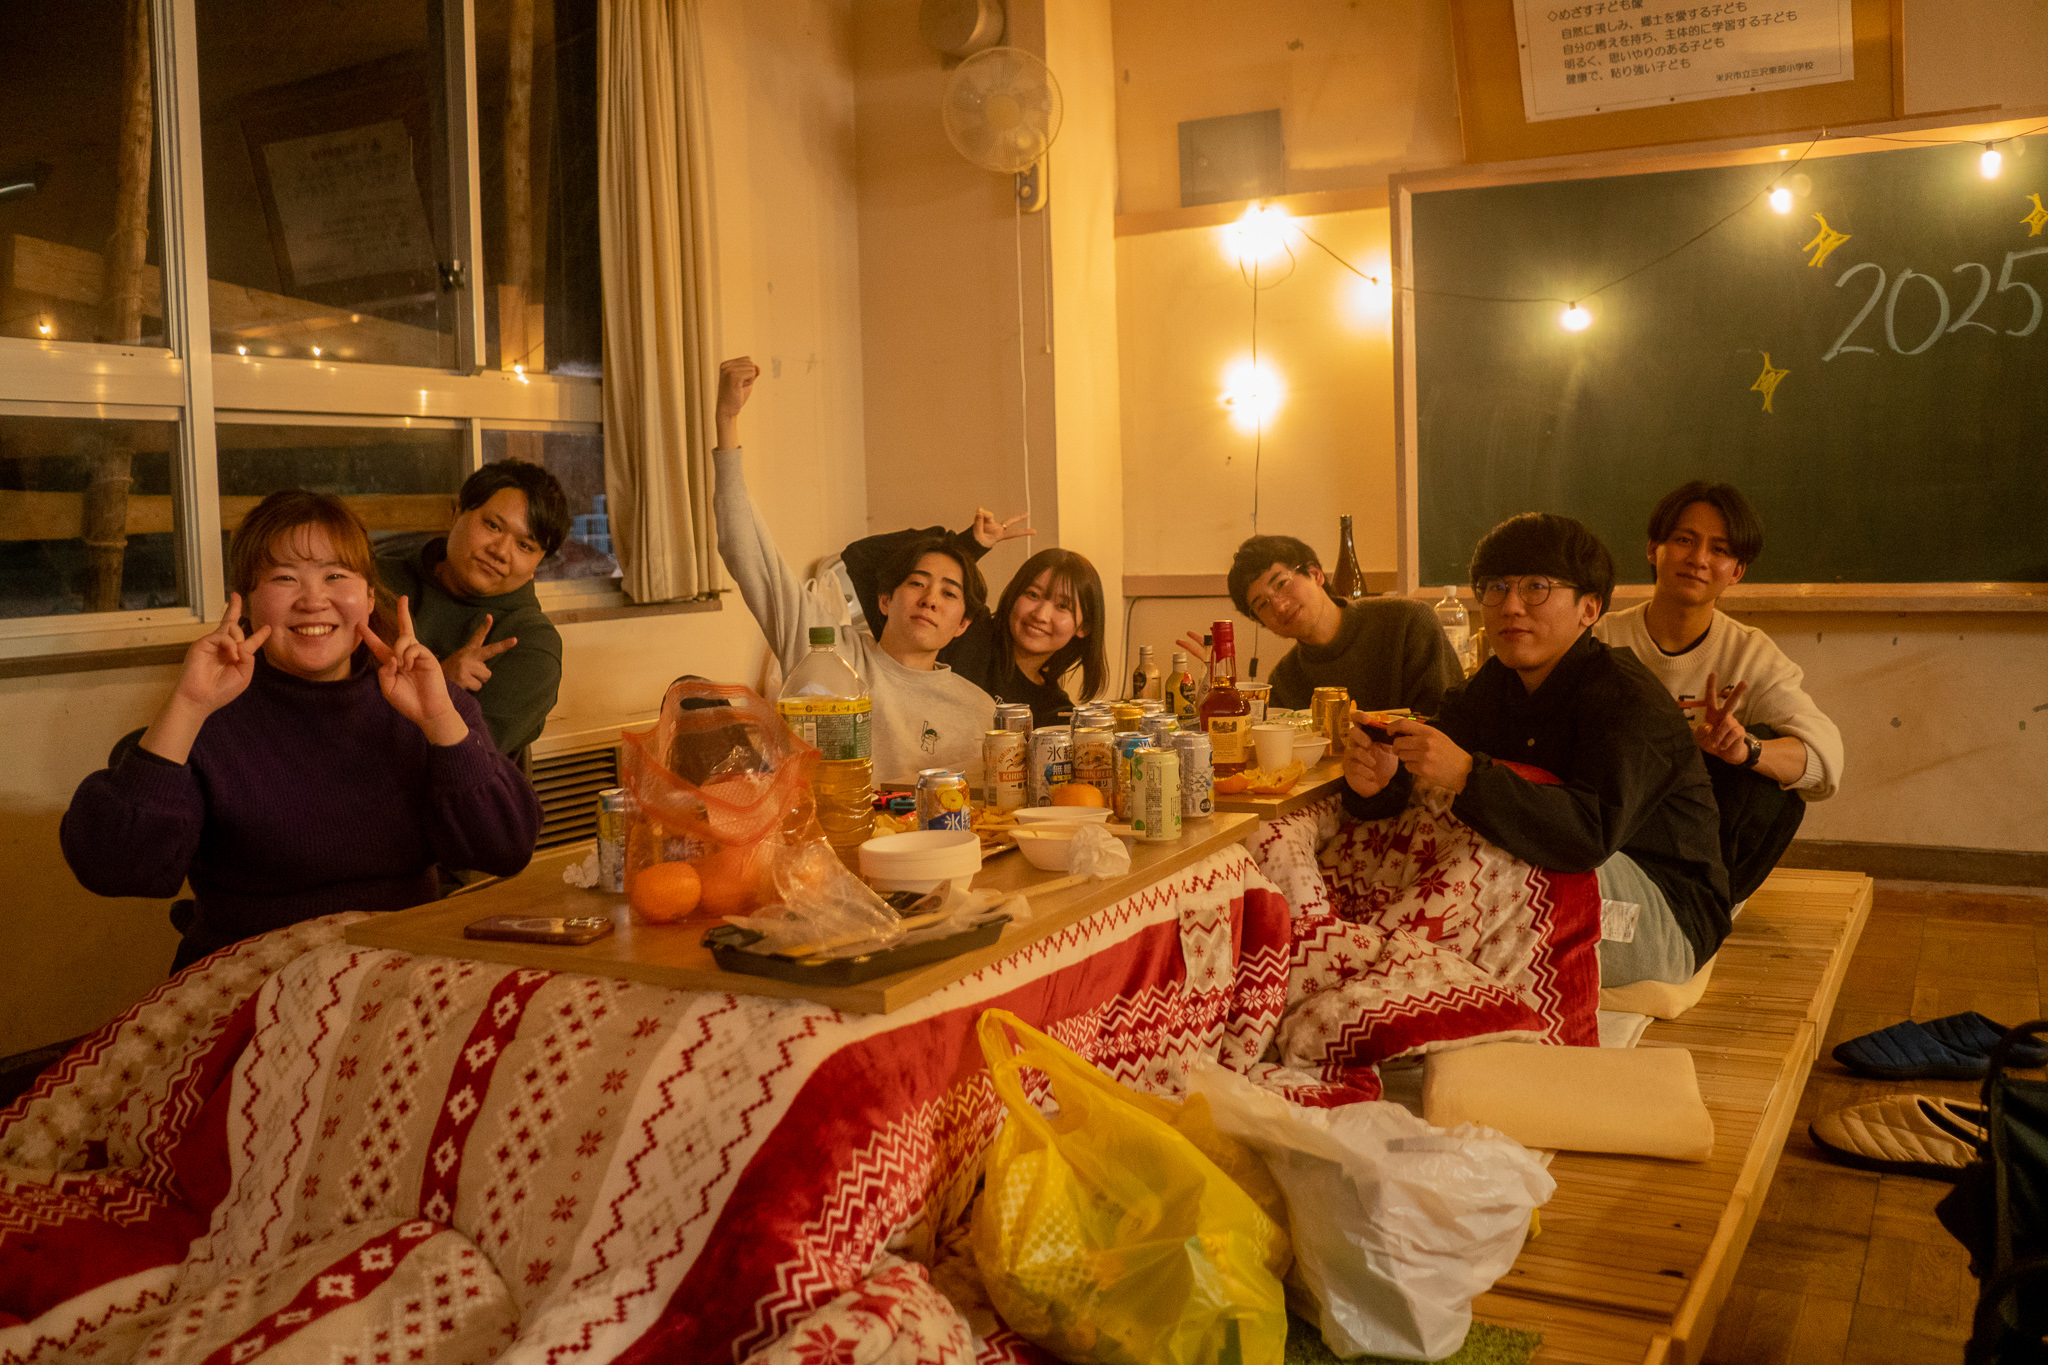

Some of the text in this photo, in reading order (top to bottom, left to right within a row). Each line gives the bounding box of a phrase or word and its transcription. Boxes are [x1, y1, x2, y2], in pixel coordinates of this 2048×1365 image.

[1564, 37, 1725, 69] 明るく、思いやりのある子ども
[1566, 58, 1691, 85] 健康で、粘り強い子ども
[1821, 246, 2048, 362] 2025
